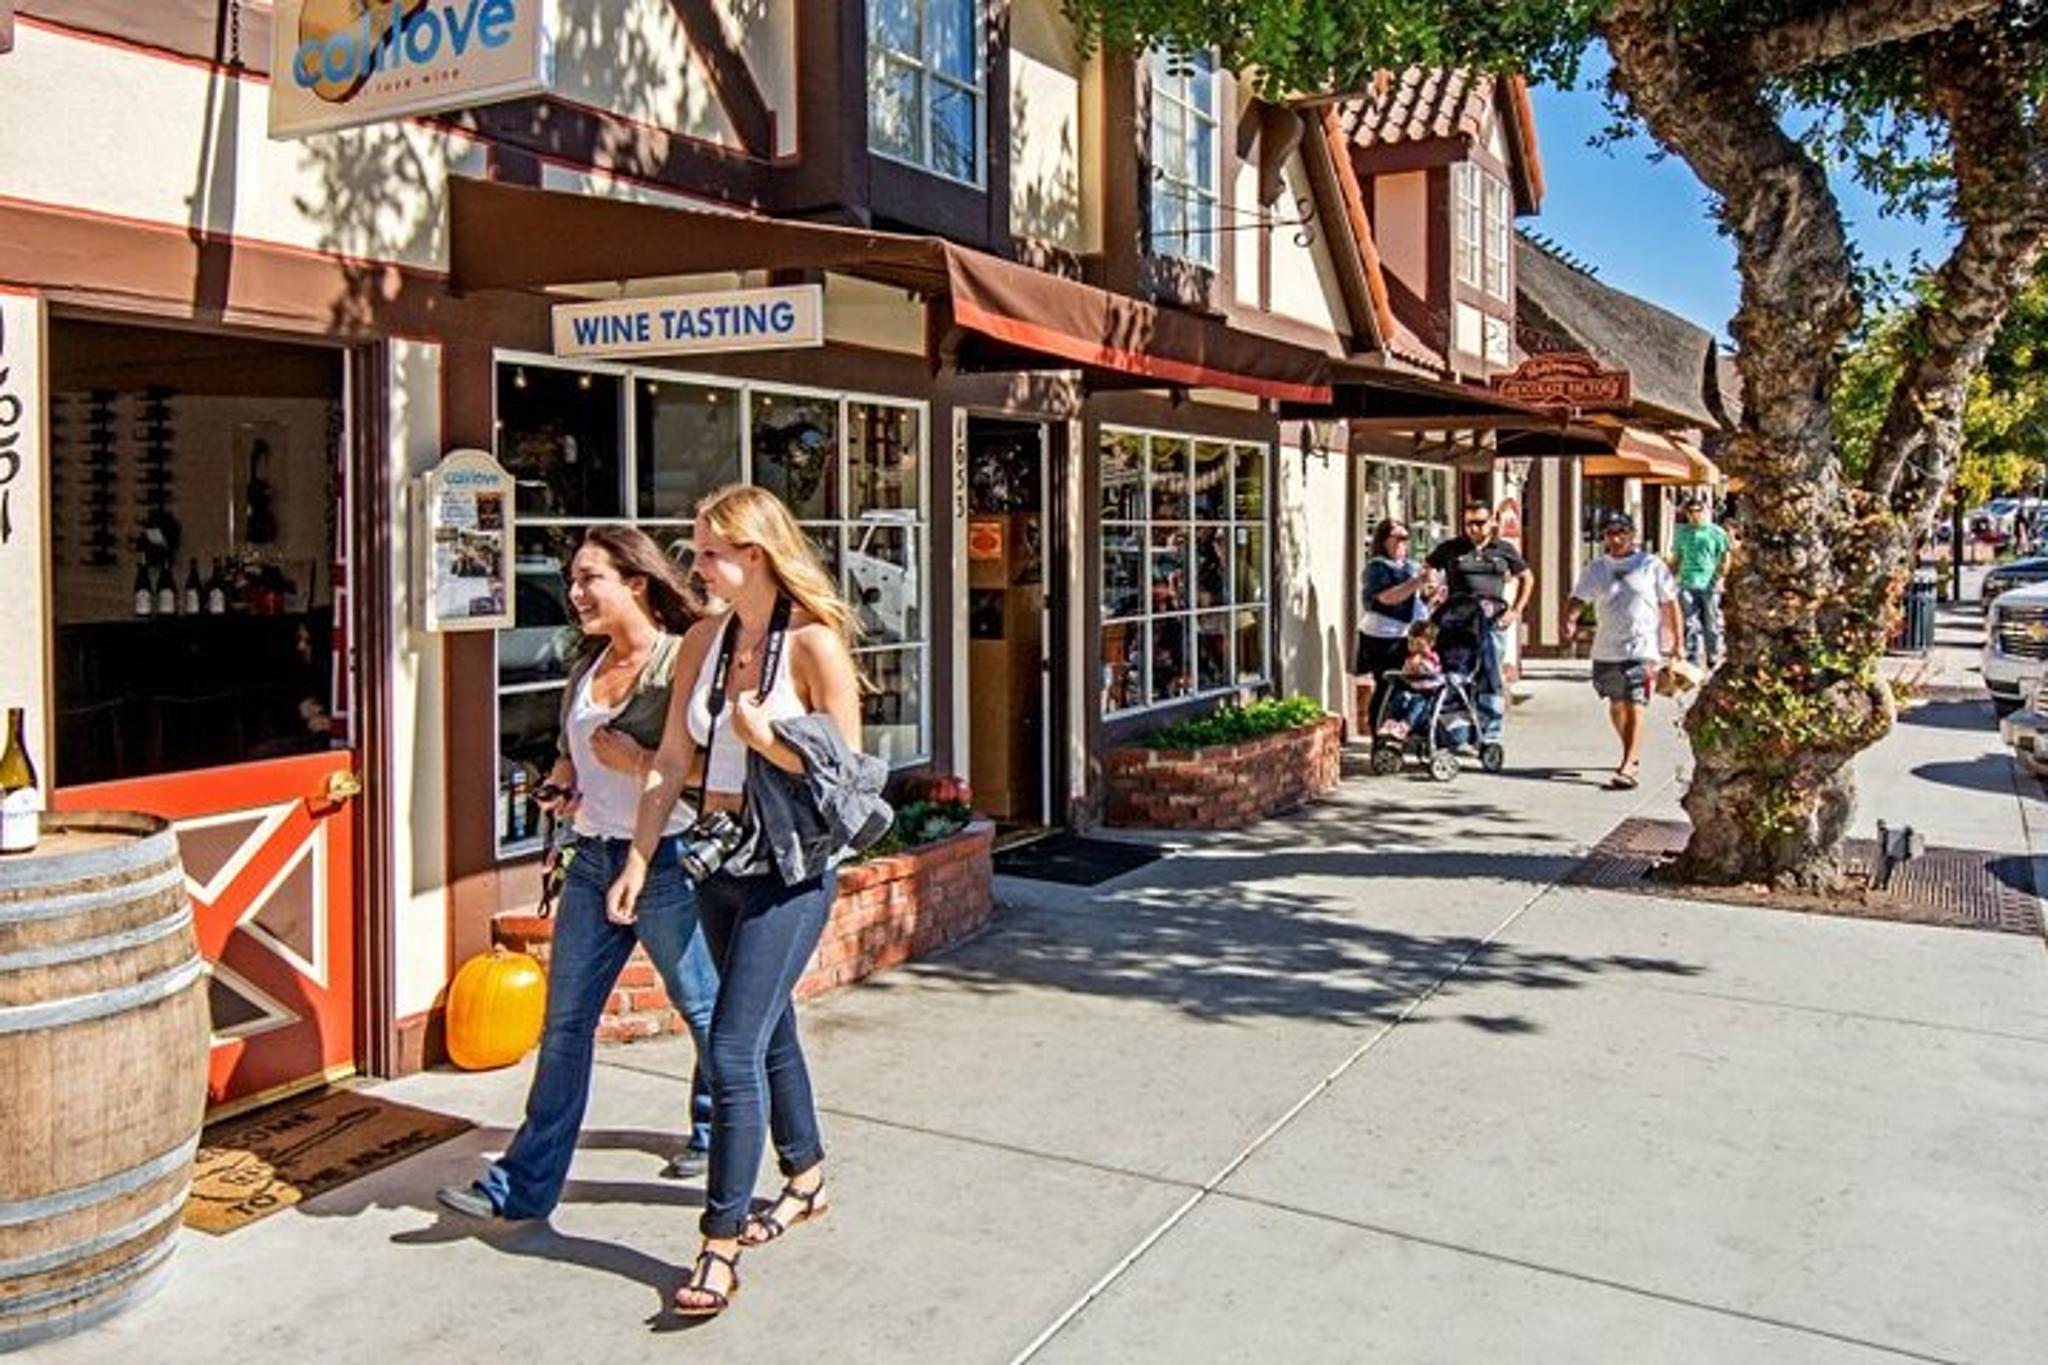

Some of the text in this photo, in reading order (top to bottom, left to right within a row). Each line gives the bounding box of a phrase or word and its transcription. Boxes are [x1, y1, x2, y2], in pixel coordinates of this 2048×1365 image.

[573, 300, 795, 346] WINE TASTING
[955, 416, 966, 518] 1653
[226, 1191, 278, 1216] TO
